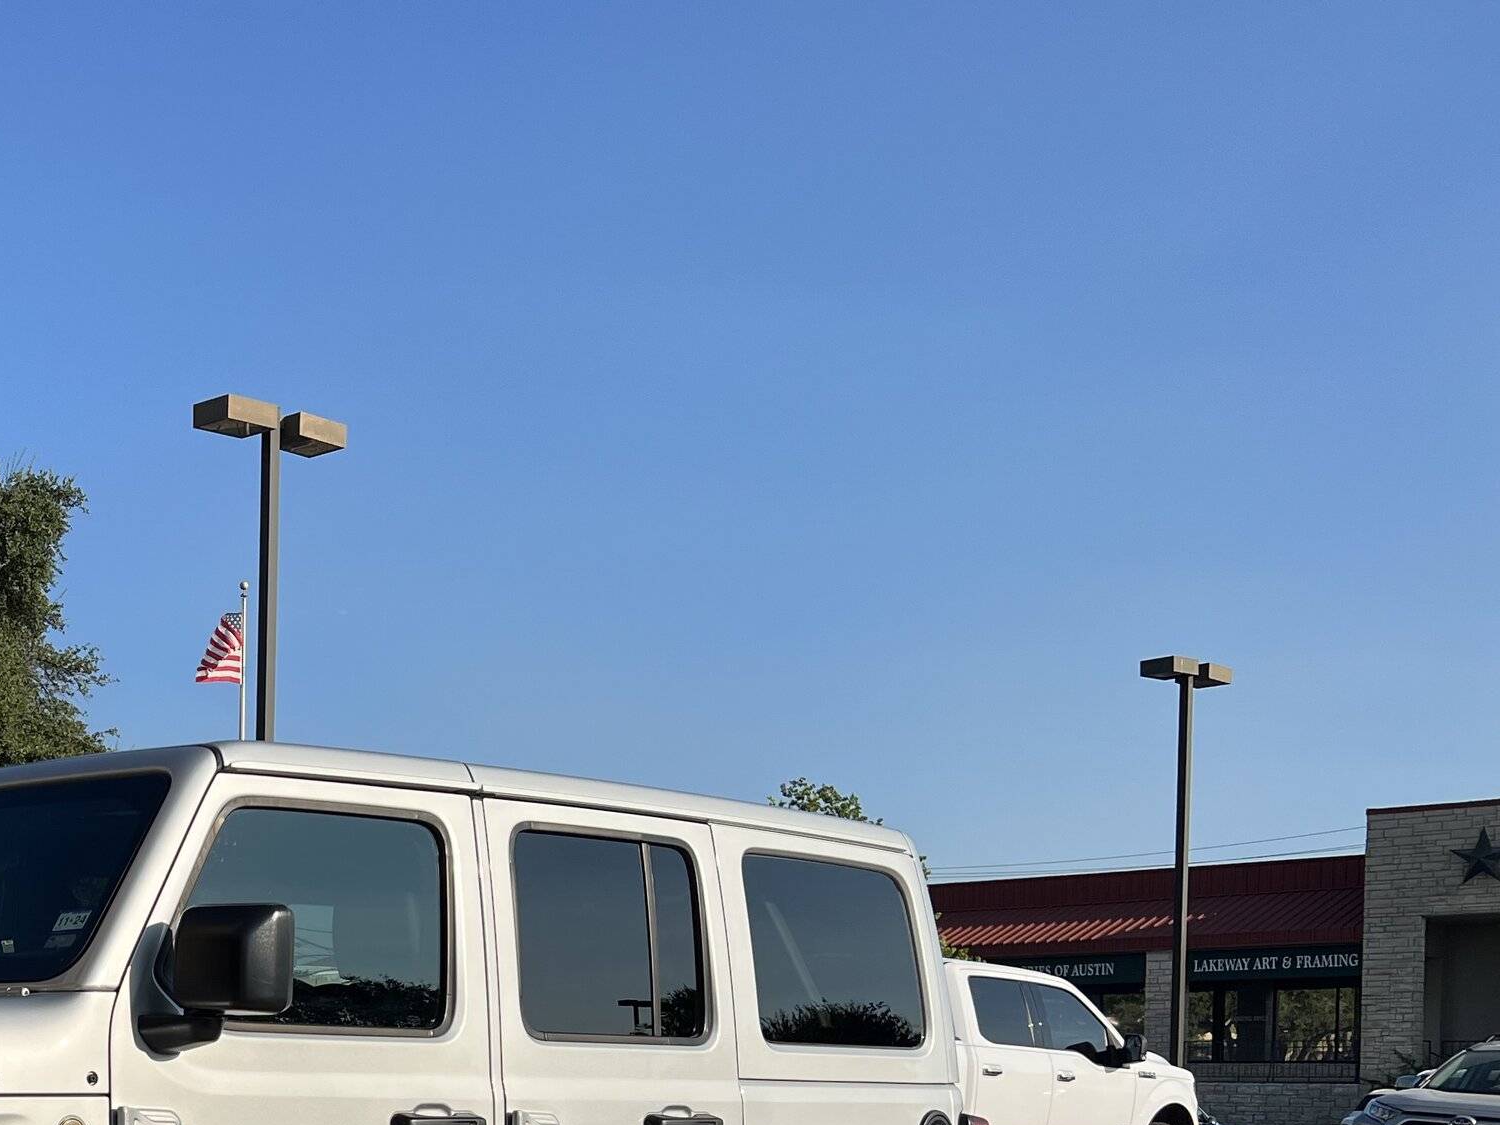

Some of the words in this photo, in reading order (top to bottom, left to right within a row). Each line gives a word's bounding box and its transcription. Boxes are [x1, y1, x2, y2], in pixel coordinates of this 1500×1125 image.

[1054, 965, 1070, 977] OF
[1071, 963, 1115, 976] AUSTIN
[1194, 958, 1250, 972] LAKEWAY
[1253, 956, 1278, 970] ART
[1282, 956, 1292, 969] &
[1296, 954, 1359, 968] FRAMING
